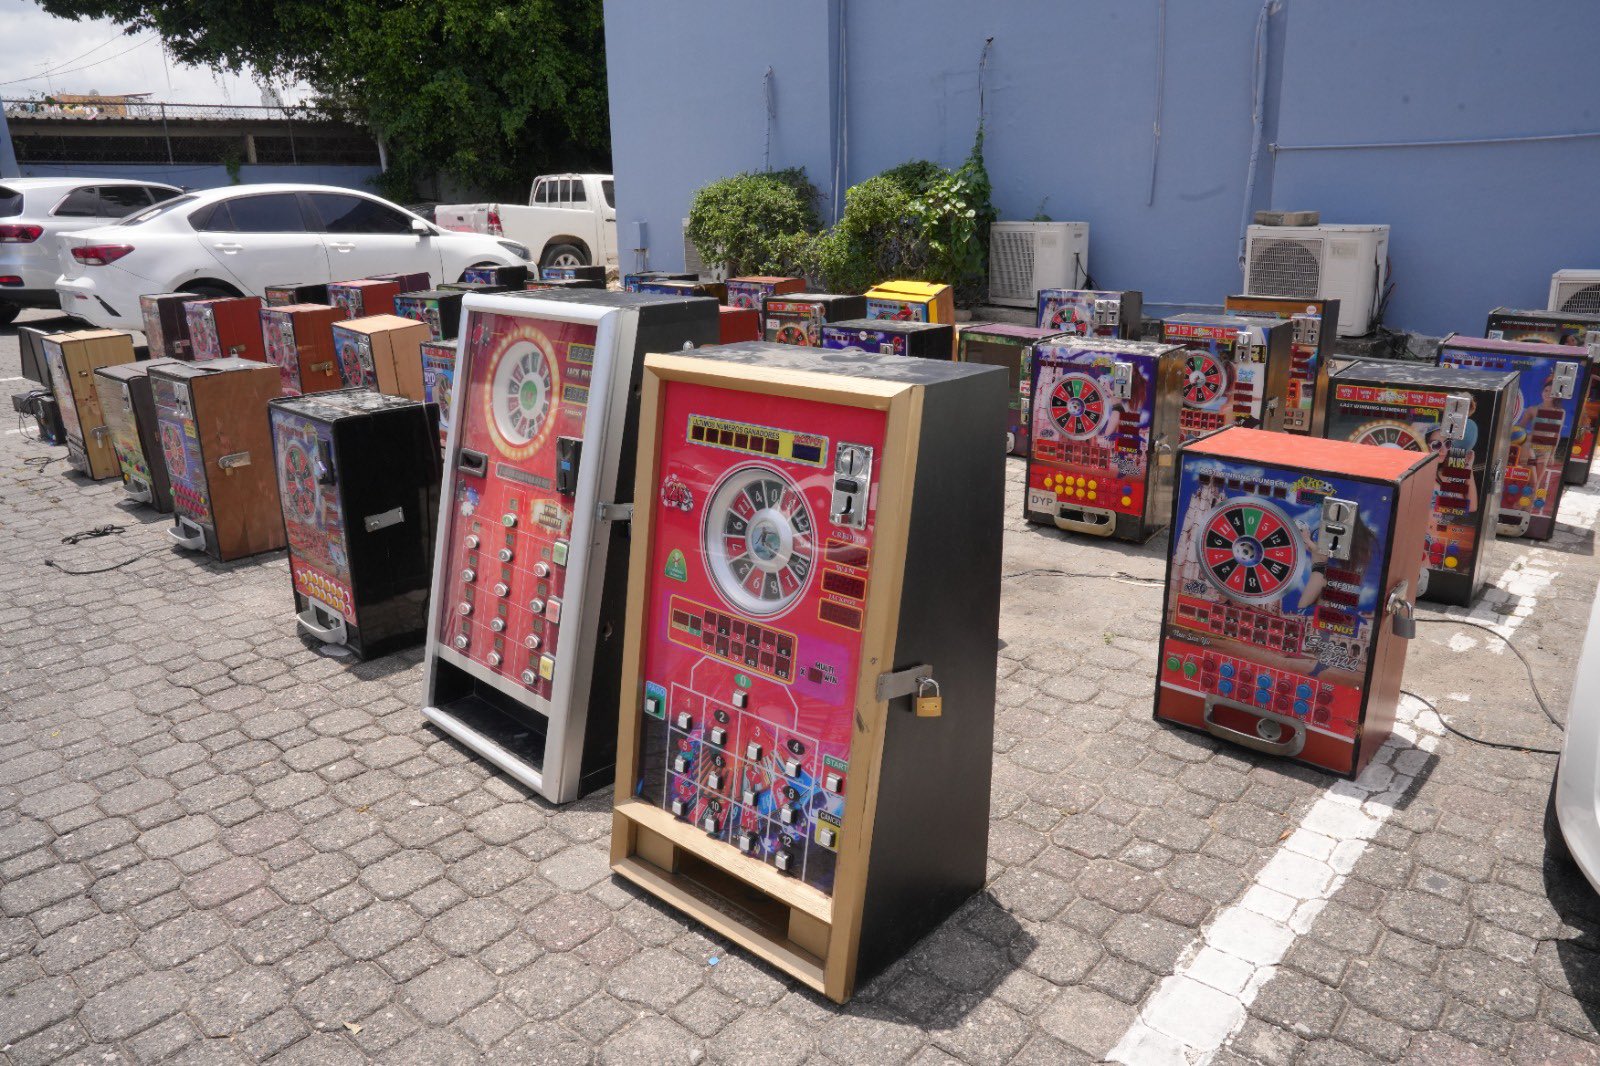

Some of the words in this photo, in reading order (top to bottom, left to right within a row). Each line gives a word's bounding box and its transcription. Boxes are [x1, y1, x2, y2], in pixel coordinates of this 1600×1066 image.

[744, 428, 780, 440] GANADORES
[756, 490, 763, 504] 4
[772, 489, 778, 500] 0
[738, 500, 750, 514] 11
[1234, 517, 1240, 526] 4
[1248, 516, 1254, 524] 0
[770, 580, 778, 594] 8
[816, 662, 834, 673] MULTI
[740, 675, 746, 686] 0
[824, 675, 838, 684] WIN
[719, 712, 725, 721] 2
[755, 726, 760, 737] 3
[792, 742, 799, 752] 4
[715, 757, 721, 766] 6
[826, 758, 847, 770] START
[789, 788, 795, 798] 8
[710, 801, 719, 810] 10
[783, 836, 792, 848] 12
